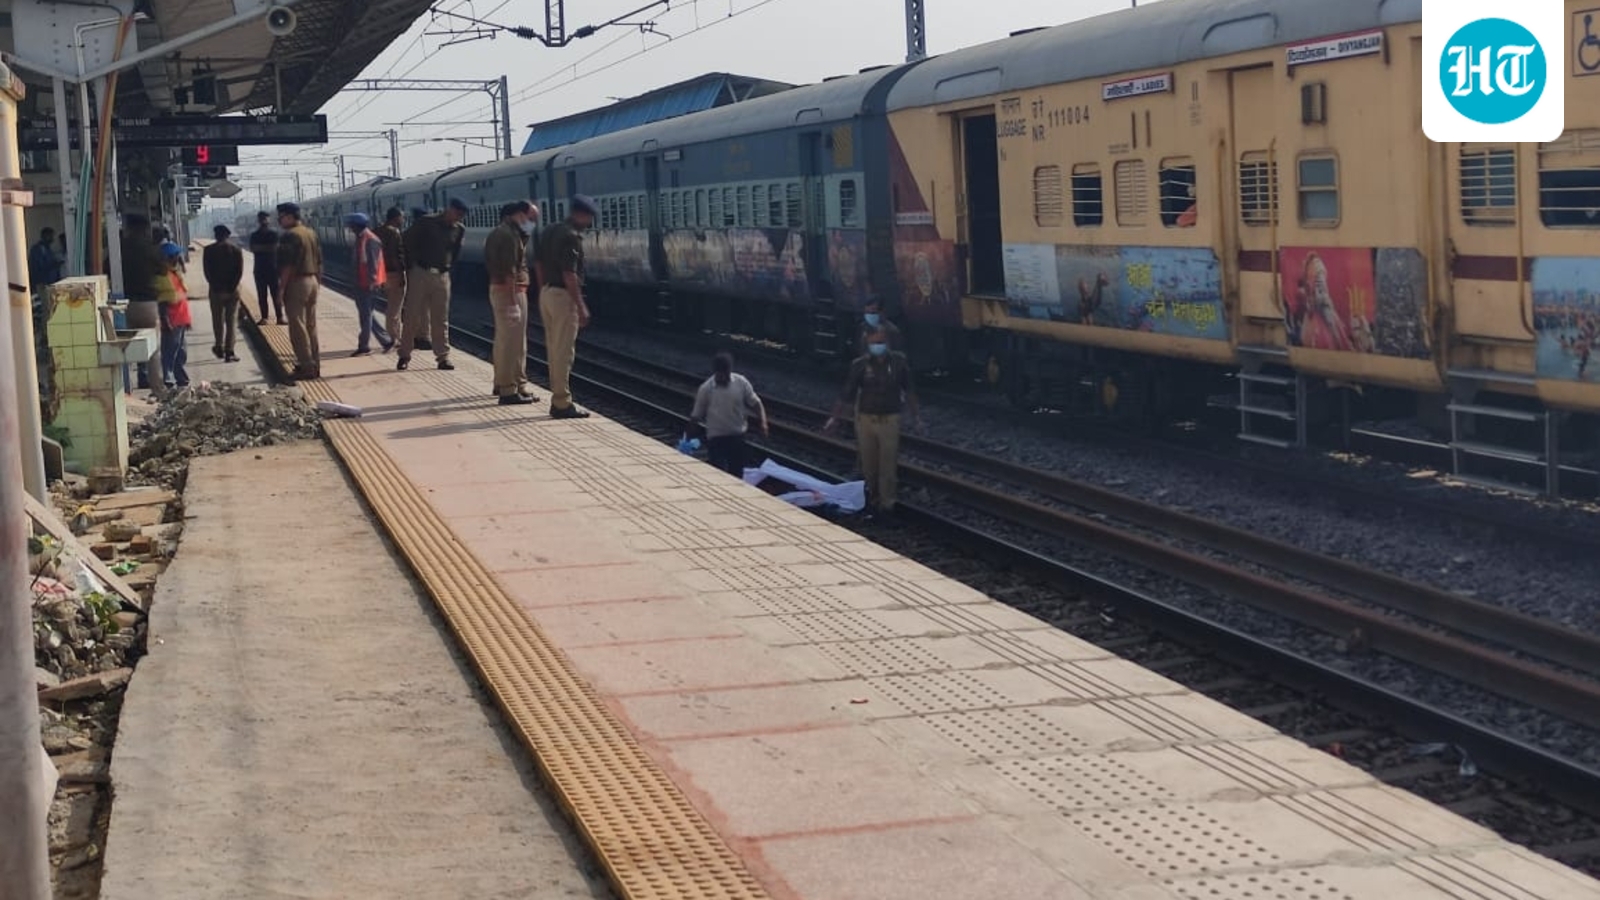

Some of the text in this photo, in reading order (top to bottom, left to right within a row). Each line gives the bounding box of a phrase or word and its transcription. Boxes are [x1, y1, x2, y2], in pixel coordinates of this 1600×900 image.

[1338, 36, 1380, 53] DIVYANGJAN
[1141, 79, 1164, 91] LADIES
[1048, 105, 1090, 128] 111004
[997, 118, 1026, 138] LUGGAGE
[1032, 124, 1045, 141] NR
[196, 145, 210, 163] 9
